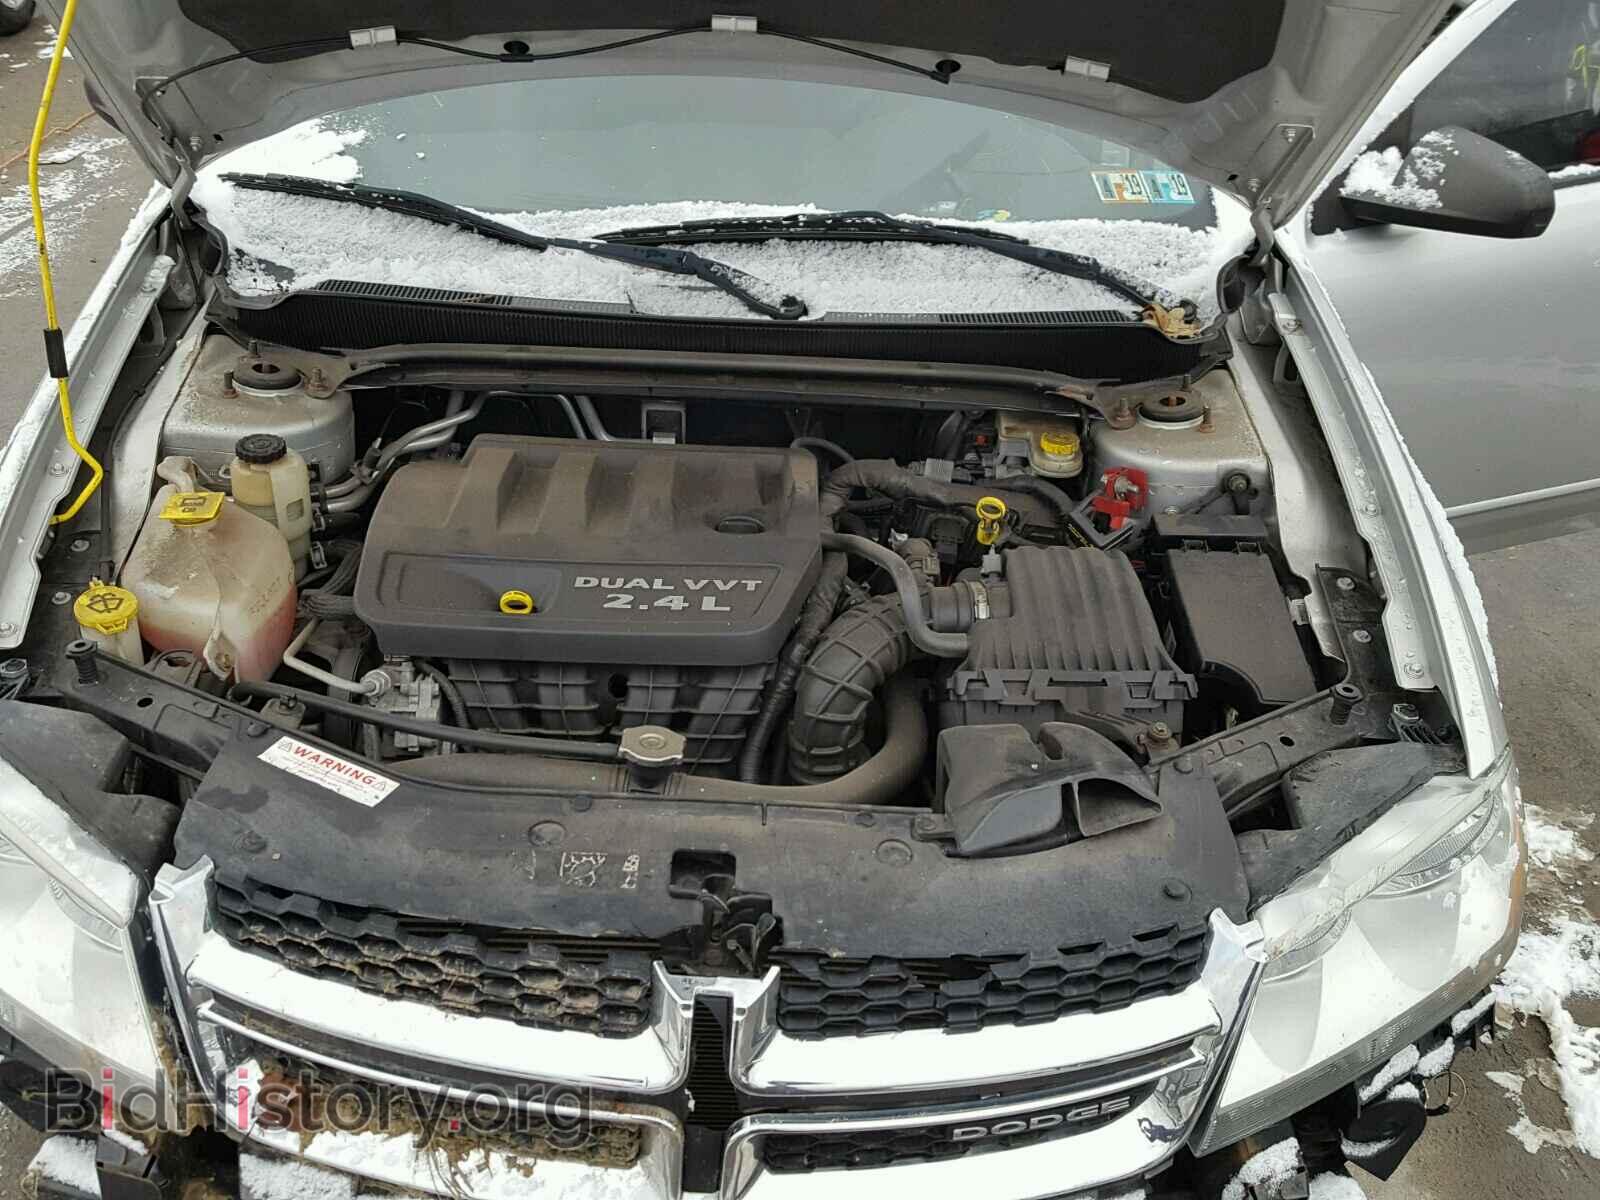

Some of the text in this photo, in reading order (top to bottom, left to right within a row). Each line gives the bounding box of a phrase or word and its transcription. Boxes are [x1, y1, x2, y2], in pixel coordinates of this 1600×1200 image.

[574, 576, 763, 592] DUAL VVT
[294, 745, 377, 785] WARNING
[951, 1096, 1132, 1142] DODGE
